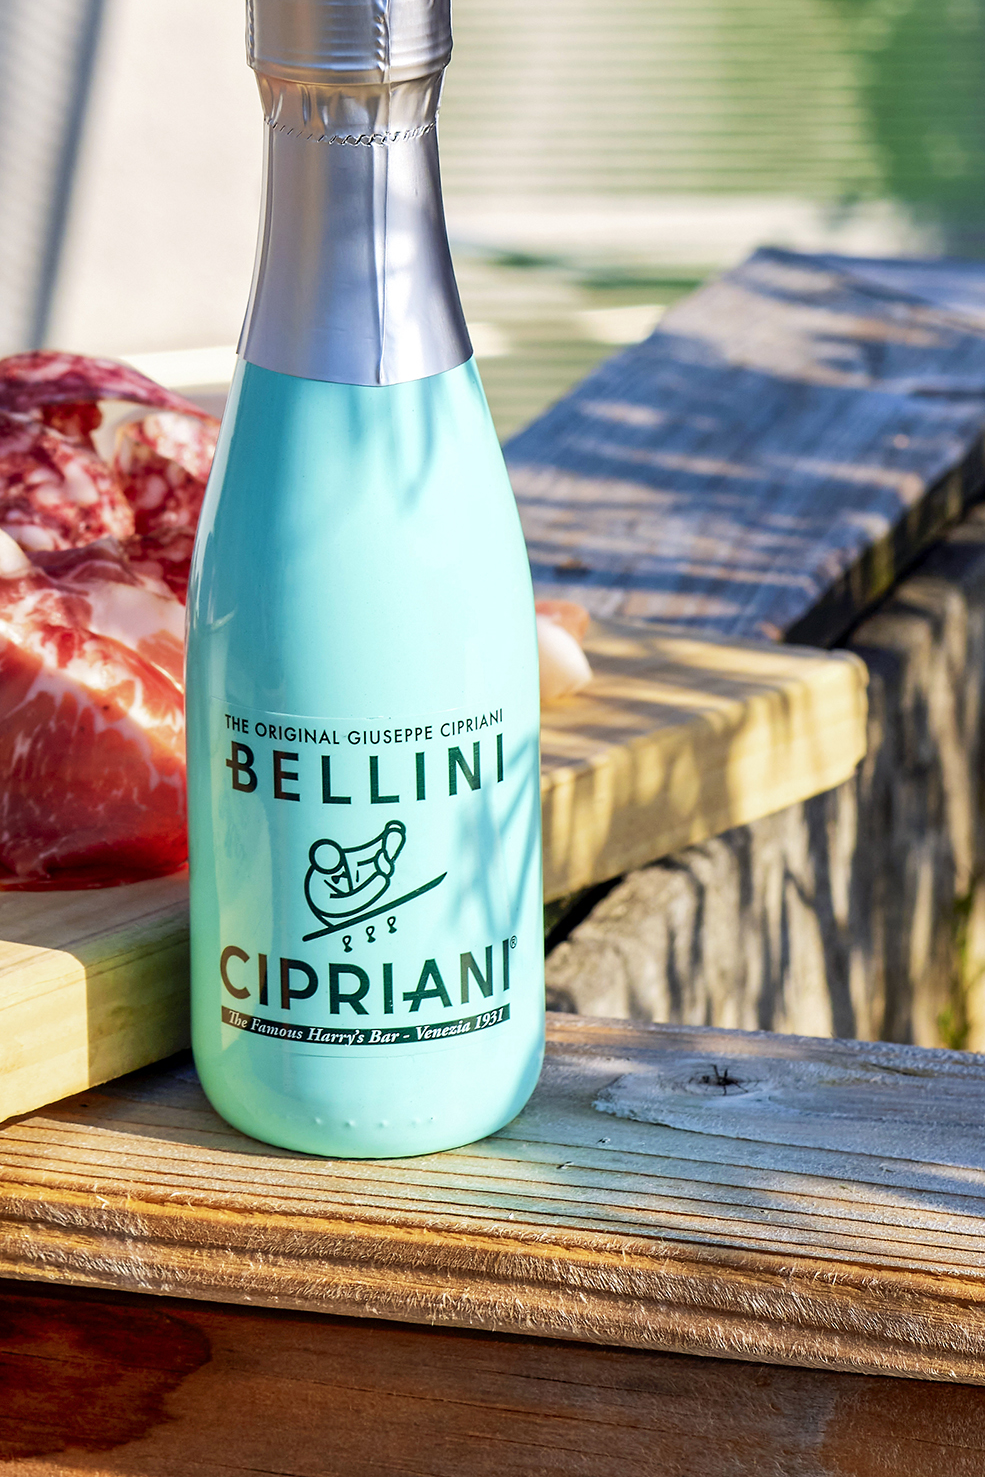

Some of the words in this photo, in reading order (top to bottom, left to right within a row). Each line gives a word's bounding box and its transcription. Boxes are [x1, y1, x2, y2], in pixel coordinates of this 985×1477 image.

[224, 714, 249, 735] THE
[254, 722, 340, 745] ORIGINAL
[347, 725, 433, 746] GIUSEPPE
[440, 708, 503, 738] CIPRIANI
[225, 732, 504, 805] BELLINI
[228, 1009, 248, 1029] The
[250, 1017, 303, 1040] Famous
[306, 1027, 365, 1047] Harry's
[368, 1029, 400, 1044] Bar
[415, 1022, 471, 1041] Venezia
[474, 1007, 505, 1030] 1931
